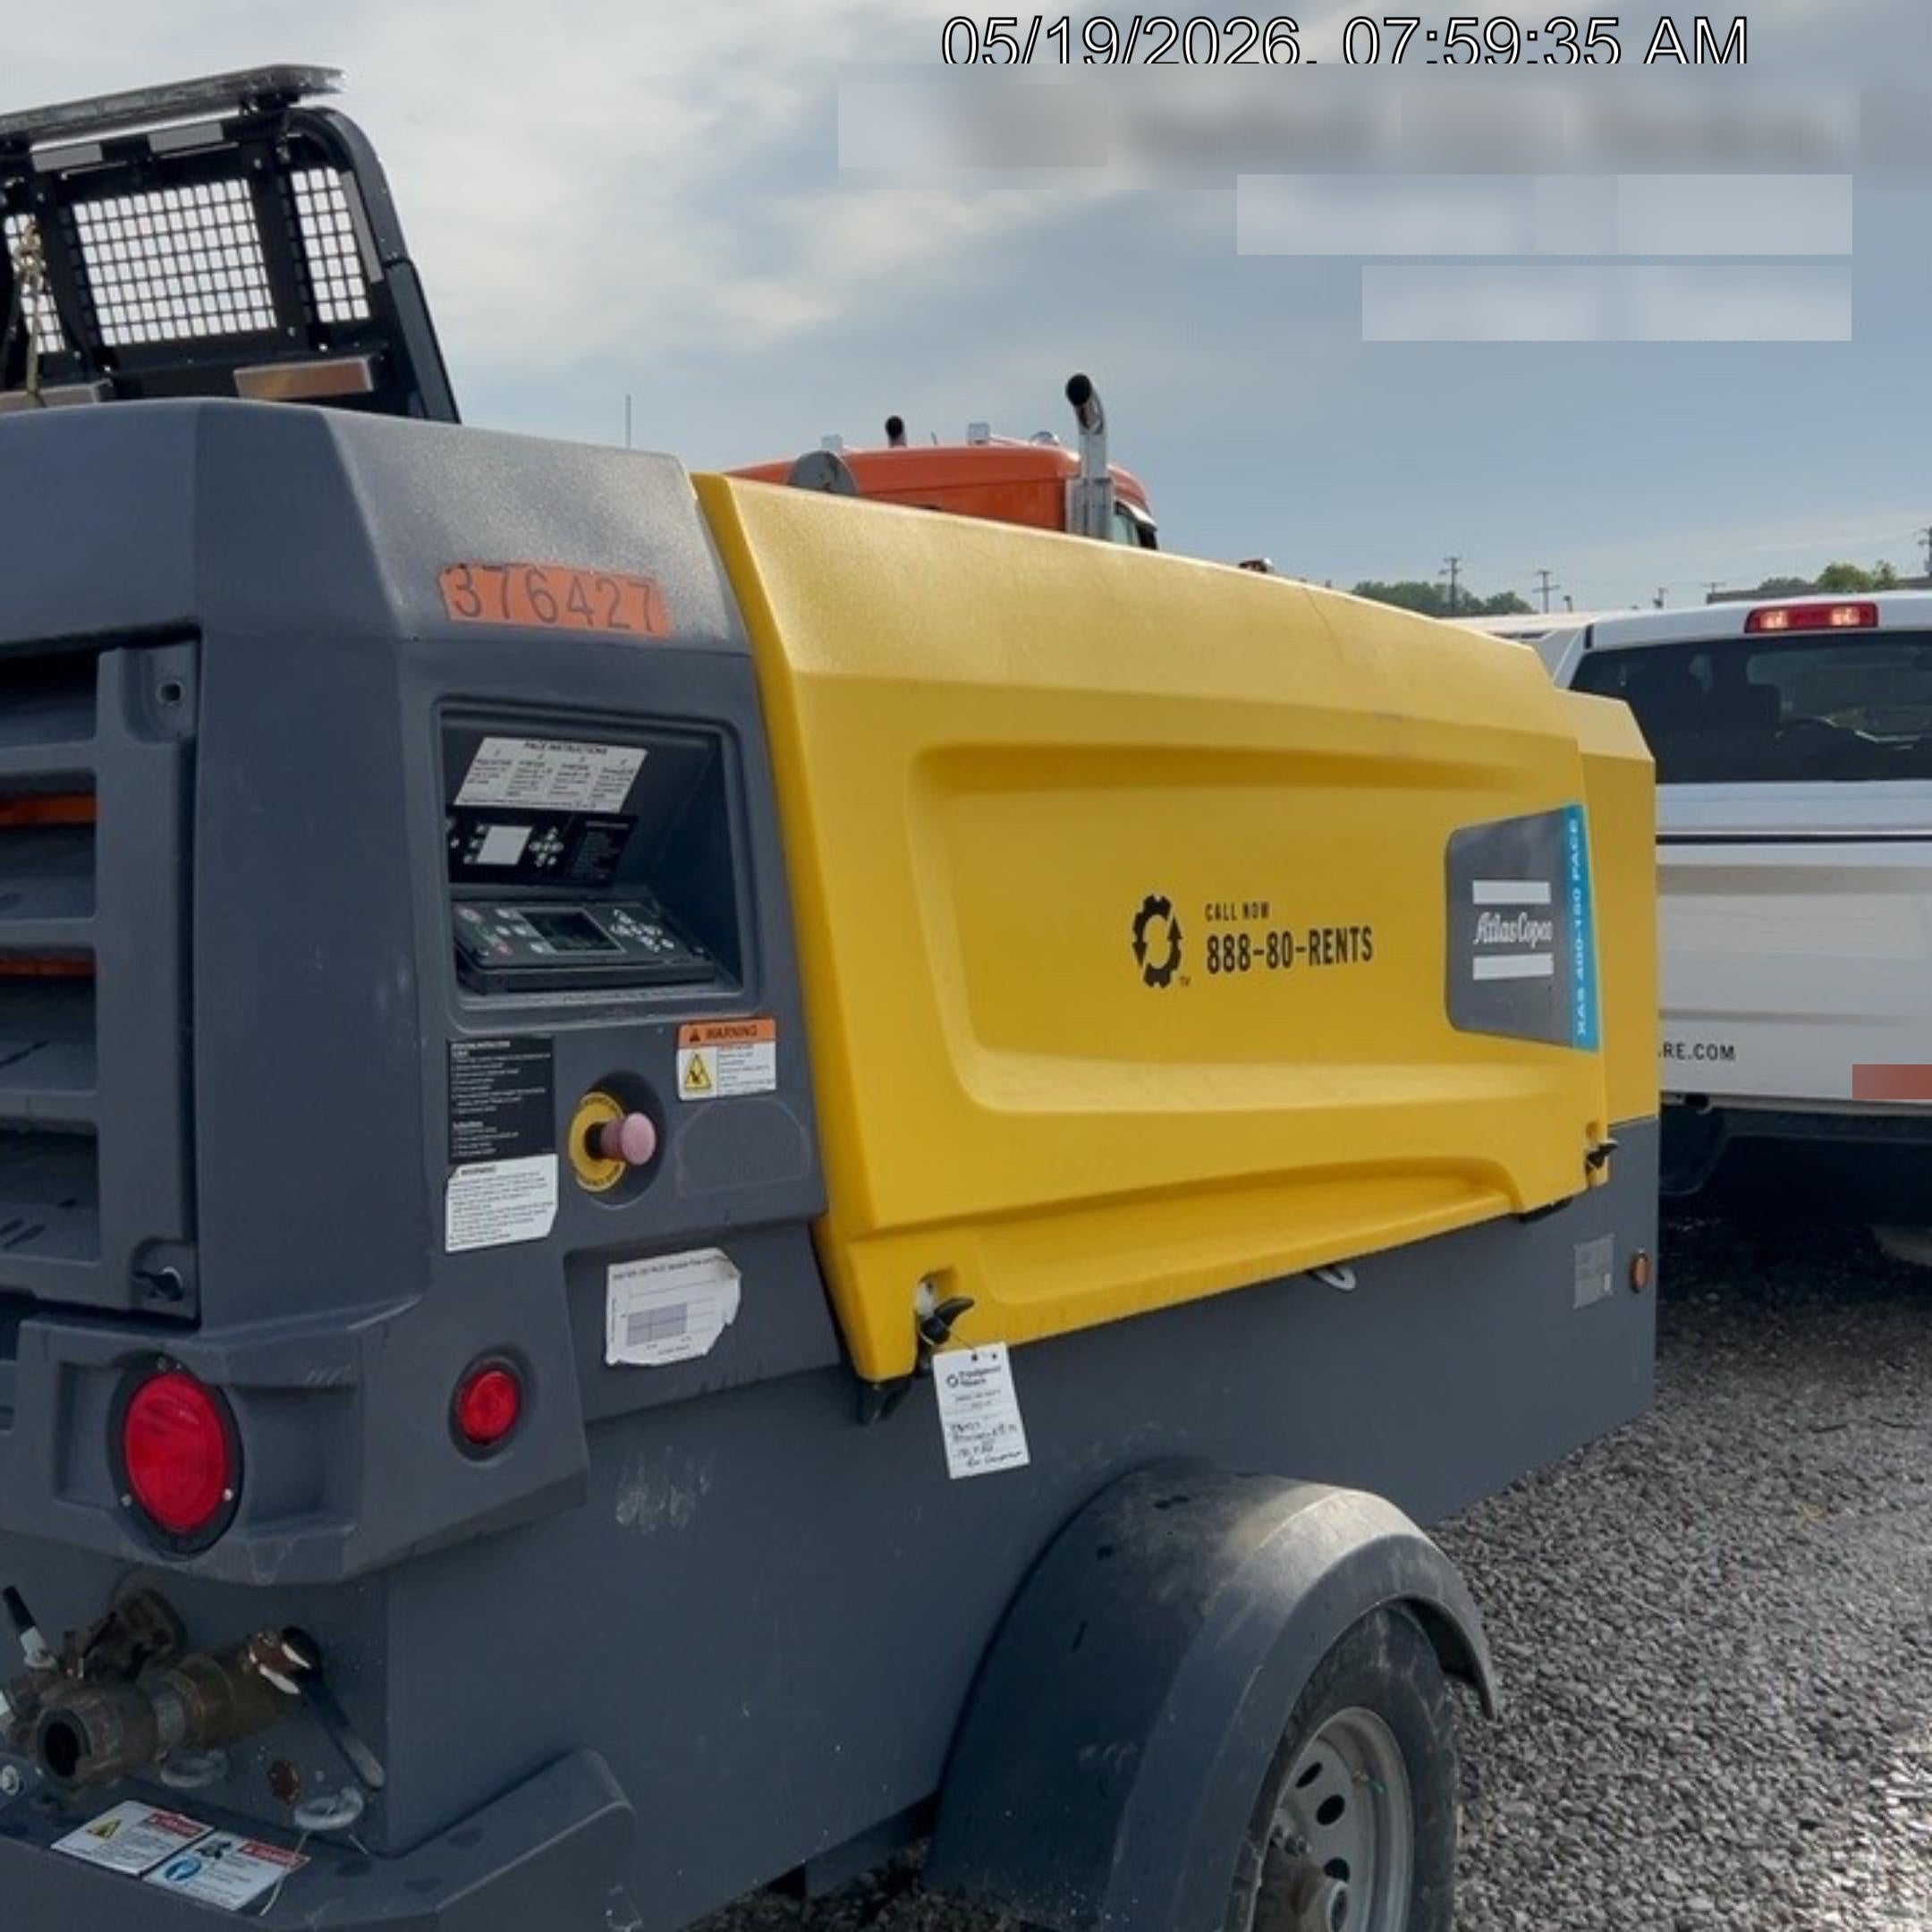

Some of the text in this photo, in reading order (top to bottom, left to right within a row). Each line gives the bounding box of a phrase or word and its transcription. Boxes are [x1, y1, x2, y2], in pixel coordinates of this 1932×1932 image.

[445, 563, 653, 632] 376427
[1568, 818, 1581, 881] PACE
[1205, 902, 1270, 921] CALL NOW
[1208, 926, 1372, 974] 888-80-RENTS
[706, 1024, 758, 1039] WARNING
[1657, 1041, 1736, 1061] RE.COM
